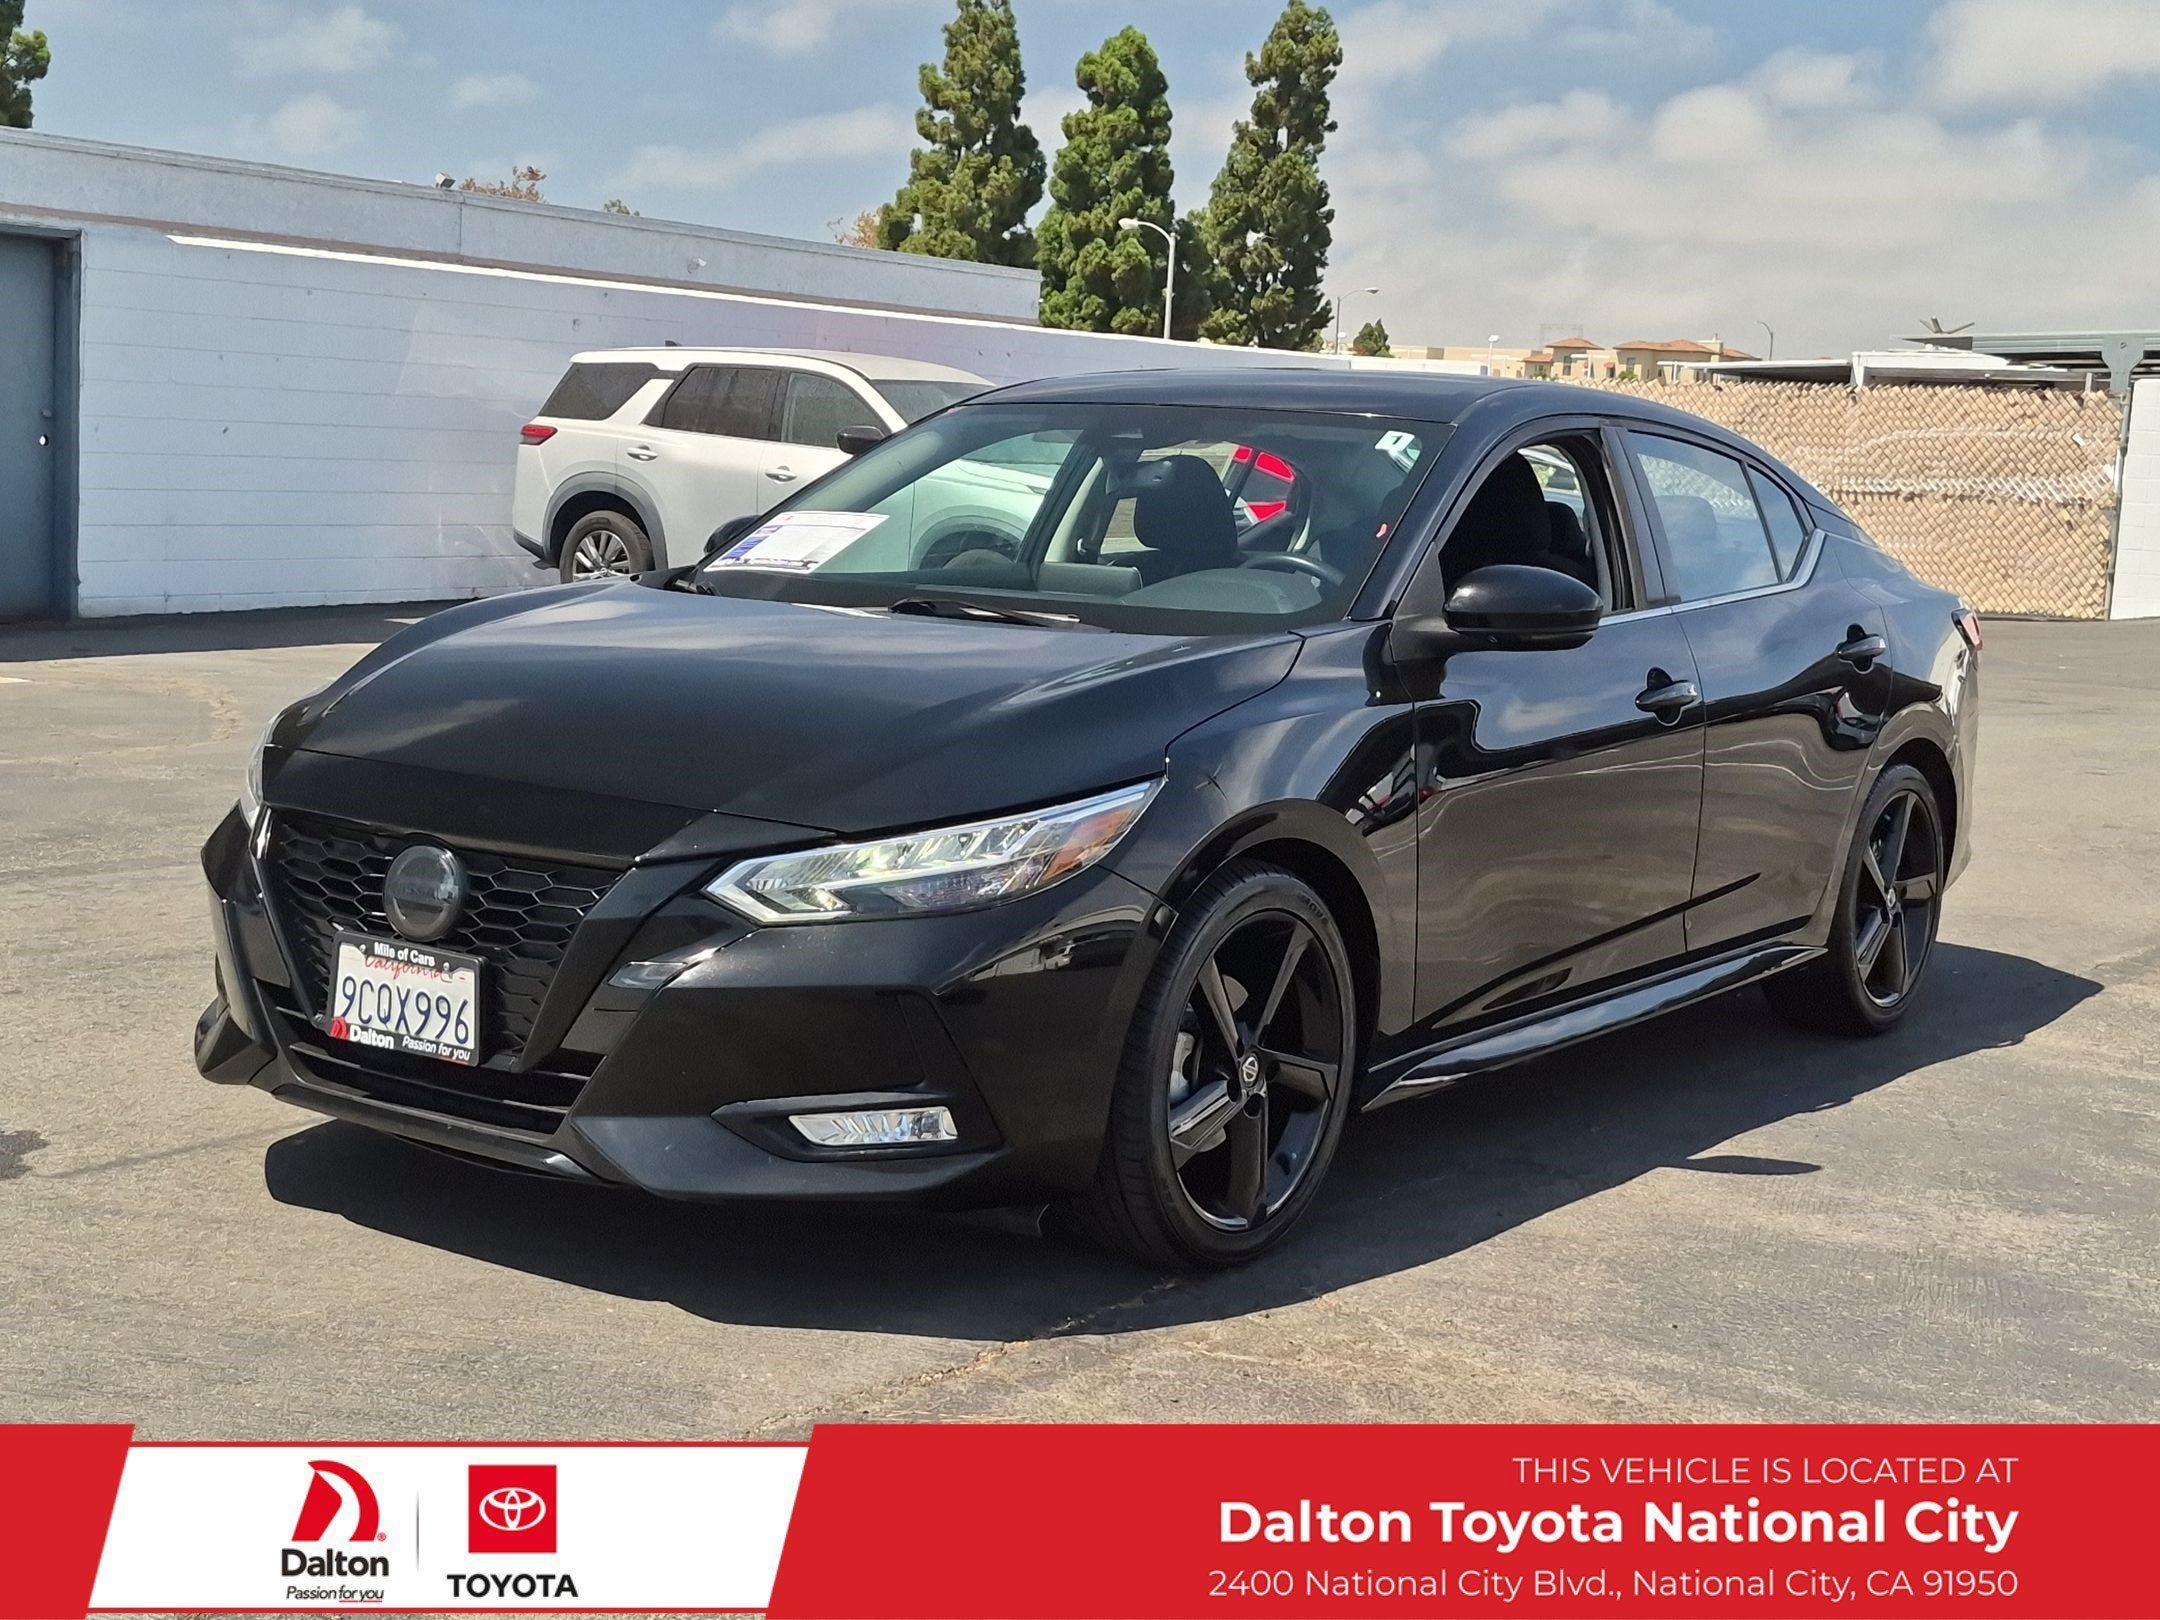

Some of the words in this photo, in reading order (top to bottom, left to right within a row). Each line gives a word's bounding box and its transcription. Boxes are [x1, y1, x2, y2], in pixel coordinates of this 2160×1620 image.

[374, 942, 396, 958] Mile
[397, 948, 409, 961] of
[410, 950, 435, 967] Cars
[341, 975, 469, 1044] 9CQX996
[349, 1024, 395, 1050] Dalton
[402, 1035, 437, 1054] Passion
[438, 1043, 451, 1057] for
[452, 1049, 471, 1061] you
